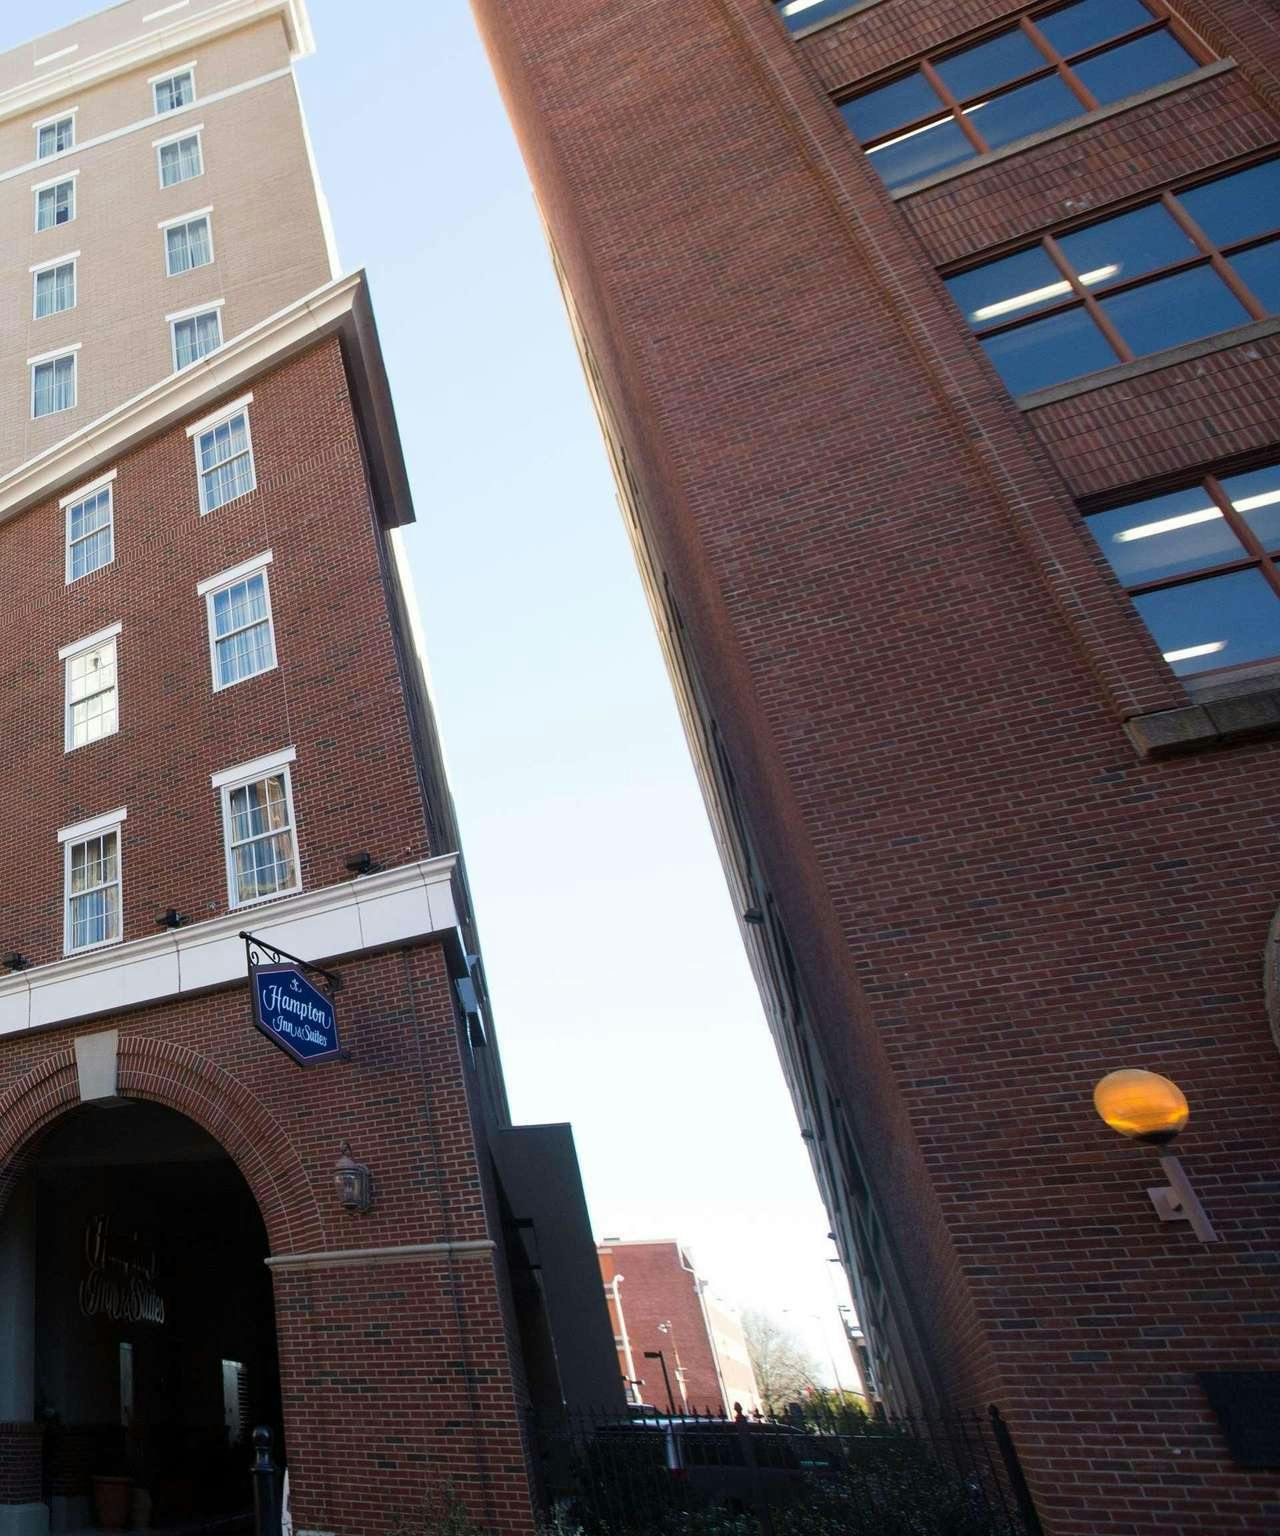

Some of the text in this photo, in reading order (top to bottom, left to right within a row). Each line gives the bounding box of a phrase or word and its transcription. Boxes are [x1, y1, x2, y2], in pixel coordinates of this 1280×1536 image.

[262, 985, 331, 1029] Hampton
[272, 1015, 297, 1037] Inn
[300, 1024, 328, 1047] Suites
